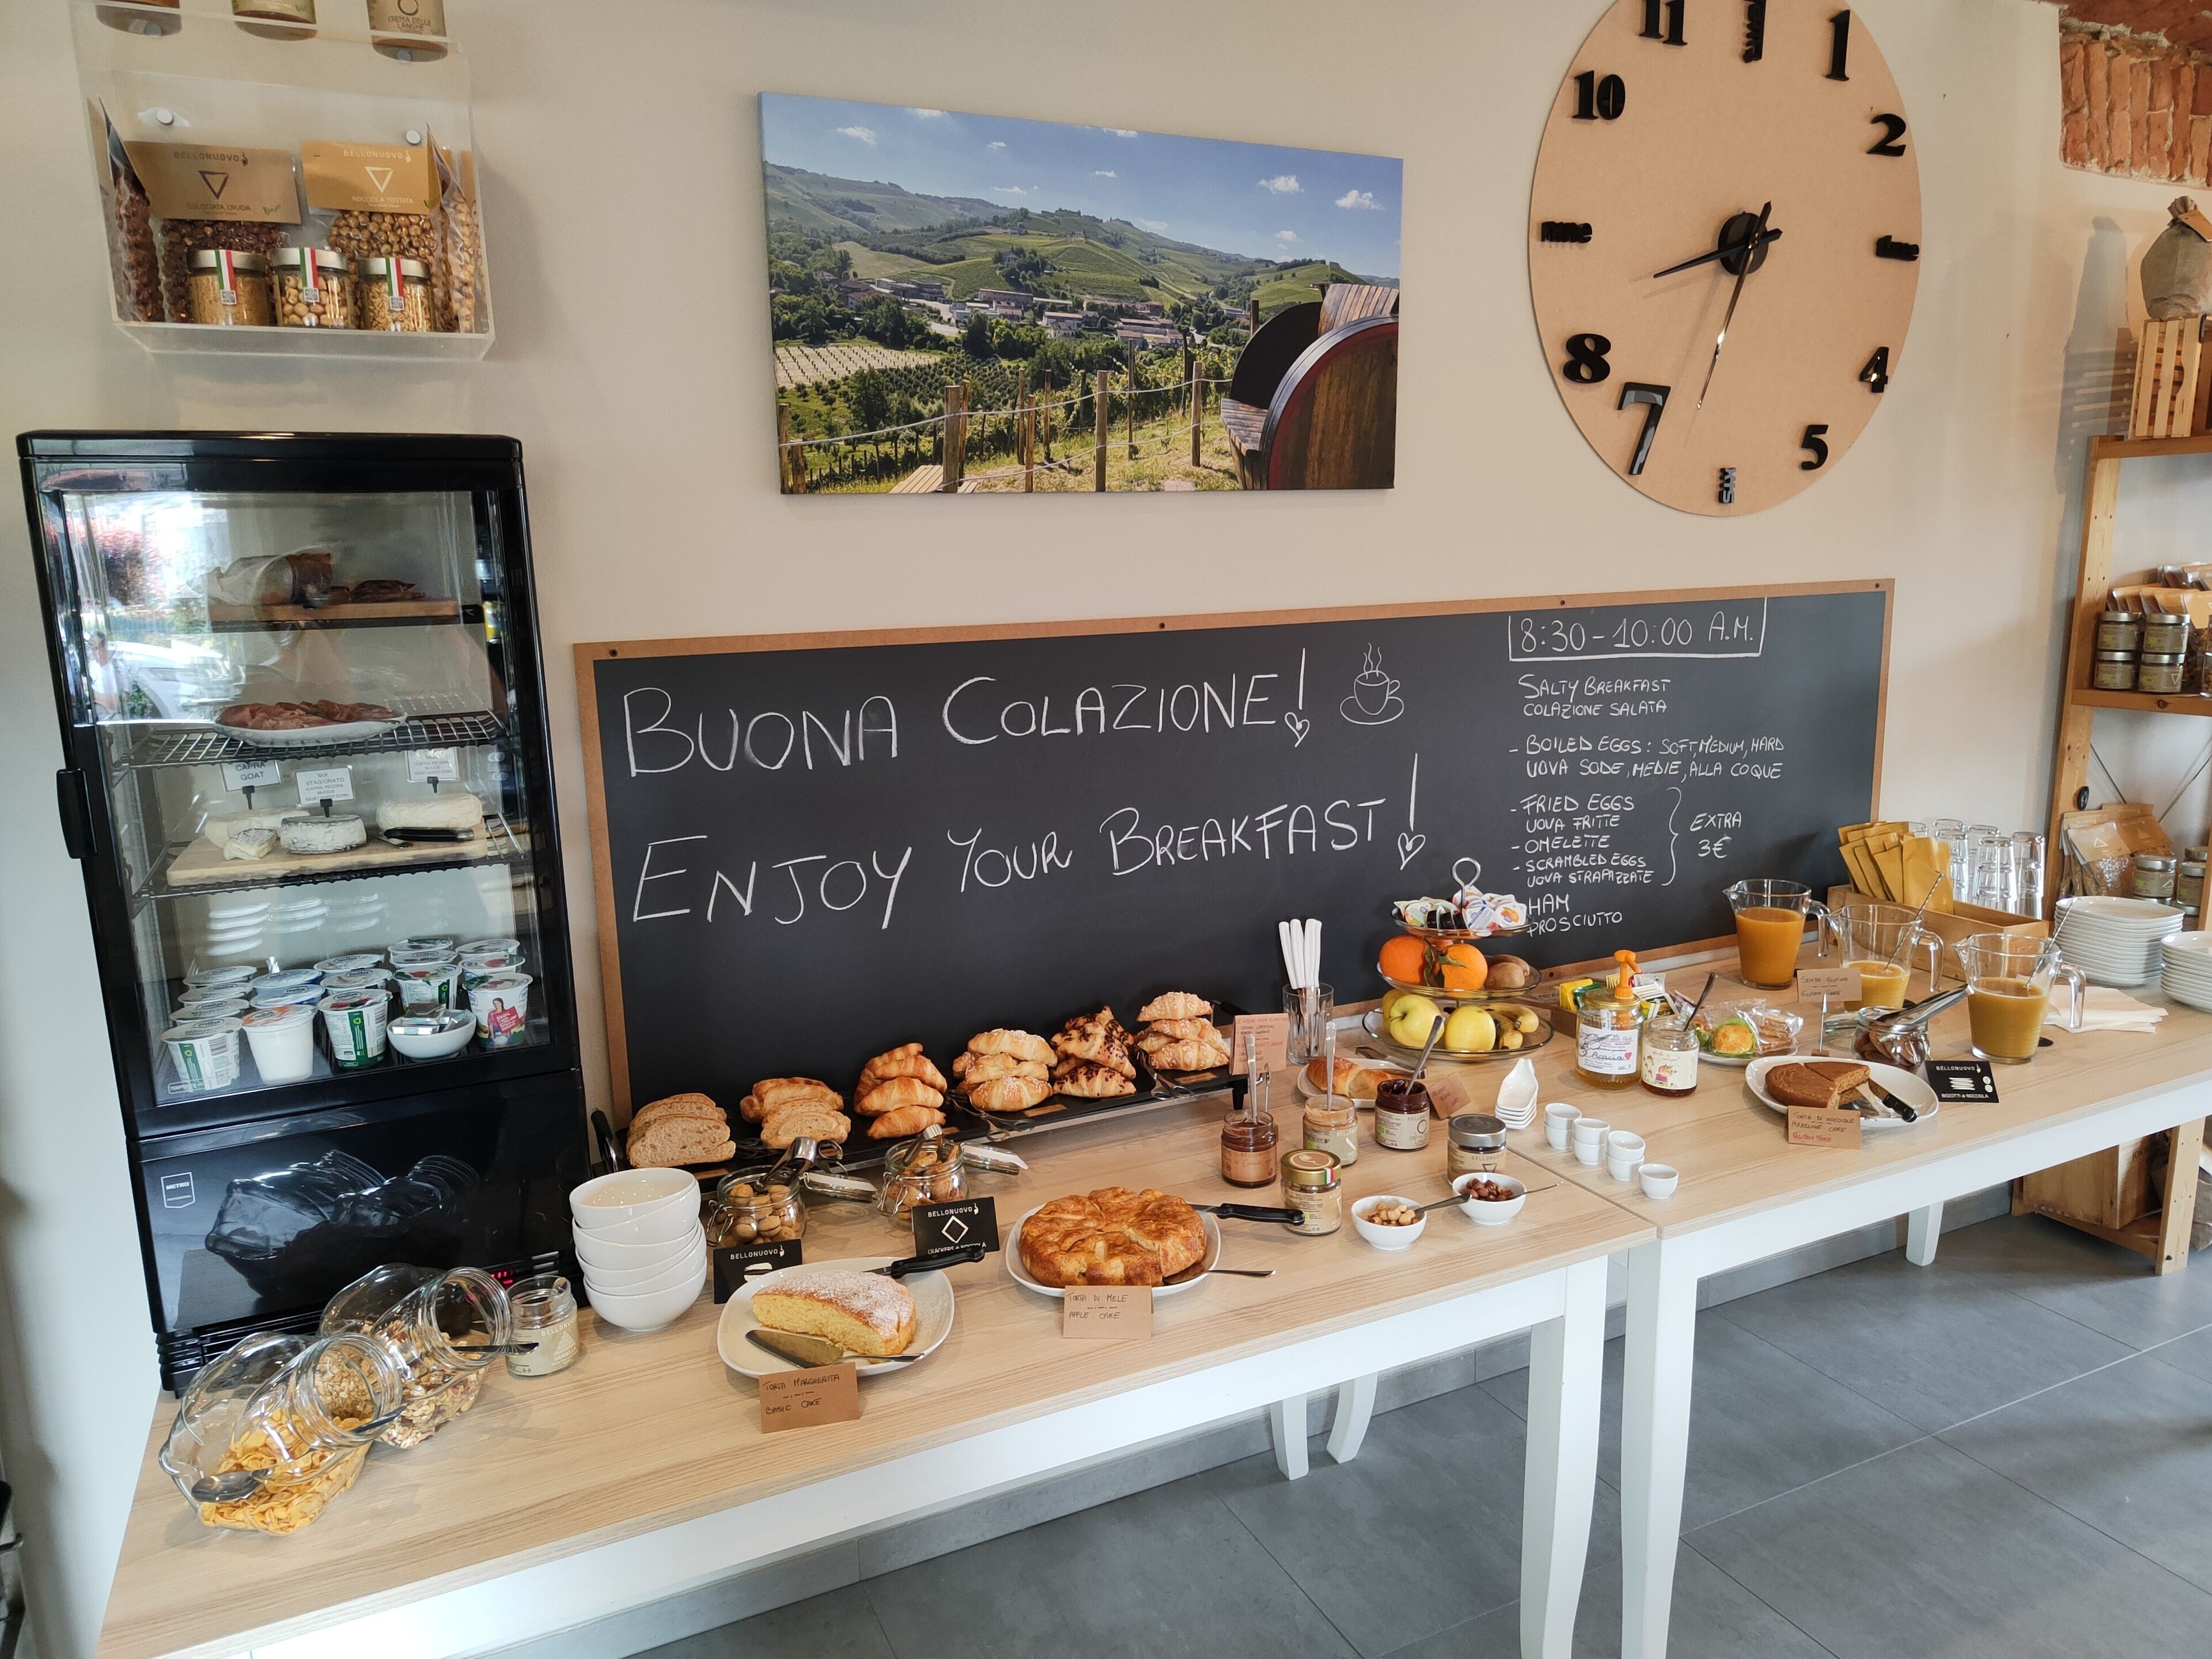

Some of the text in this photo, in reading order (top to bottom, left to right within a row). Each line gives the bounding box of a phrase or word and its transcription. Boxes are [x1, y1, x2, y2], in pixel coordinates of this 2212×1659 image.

[1639, 0, 1688, 46] 11
[1825, 9, 1851, 82] 1
[1572, 70, 1626, 121] 10
[1866, 113, 1907, 157] 2
[173, 151, 239, 162] BELLONUOVO
[343, 149, 404, 159] BELLONUOVO
[1563, 333, 1612, 384] 8
[1859, 346, 1889, 393] 4
[1617, 381, 1672, 475] 7
[1801, 424, 1830, 471] 5
[1707, 611, 1754, 642] A.M.
[1518, 674, 1671, 703] SALTY BREAKFAST
[1524, 699, 1666, 719] COLAZIONE SALATA
[624, 687, 897, 777] BUONA
[1526, 734, 1593, 755] BOILED
[1751, 736, 1785, 752] HARD
[236, 761, 266, 772] CAPRA
[240, 771, 265, 781] GOAT
[1526, 759, 1569, 778] UOVA
[1689, 760, 1722, 777] ALLA
[1730, 762, 1783, 779] COQUE
[305, 778, 344, 786] STAGIONATO
[1520, 793, 1579, 815] FRIED
[1587, 794, 1635, 811] EGGS
[1526, 814, 1621, 834] UOVA FRITTE
[1690, 811, 1742, 832] EXTRA
[1524, 835, 1611, 854] OMELETTE
[1698, 835, 1733, 859] 3€
[1525, 853, 1608, 872] SCRAMBLED
[1610, 853, 1647, 868] EGGS
[632, 835, 912, 930] ENJOY
[947, 827, 1073, 893] YOUR
[1527, 868, 1655, 888] UOVA STRAPAZZATE
[1528, 893, 1570, 916] HAM
[1527, 911, 1623, 937] PROSCIUTTO
[1592, 1051, 1624, 1060] Acacia
[1791, 1121, 1823, 1130] HAZELNUT
[166, 1181, 190, 1190] METRO
[927, 1206, 973, 1218] BELLONUOVO
[730, 1248, 778, 1260] BELLONUOVO
[1067, 1291, 1129, 1302] TORTA DI MELE
[1069, 1311, 1122, 1319] APPLE CAKE
[763, 1373, 840, 1392] TORTA MARGHERITA
[765, 1397, 822, 1415] BASIC CAKE
